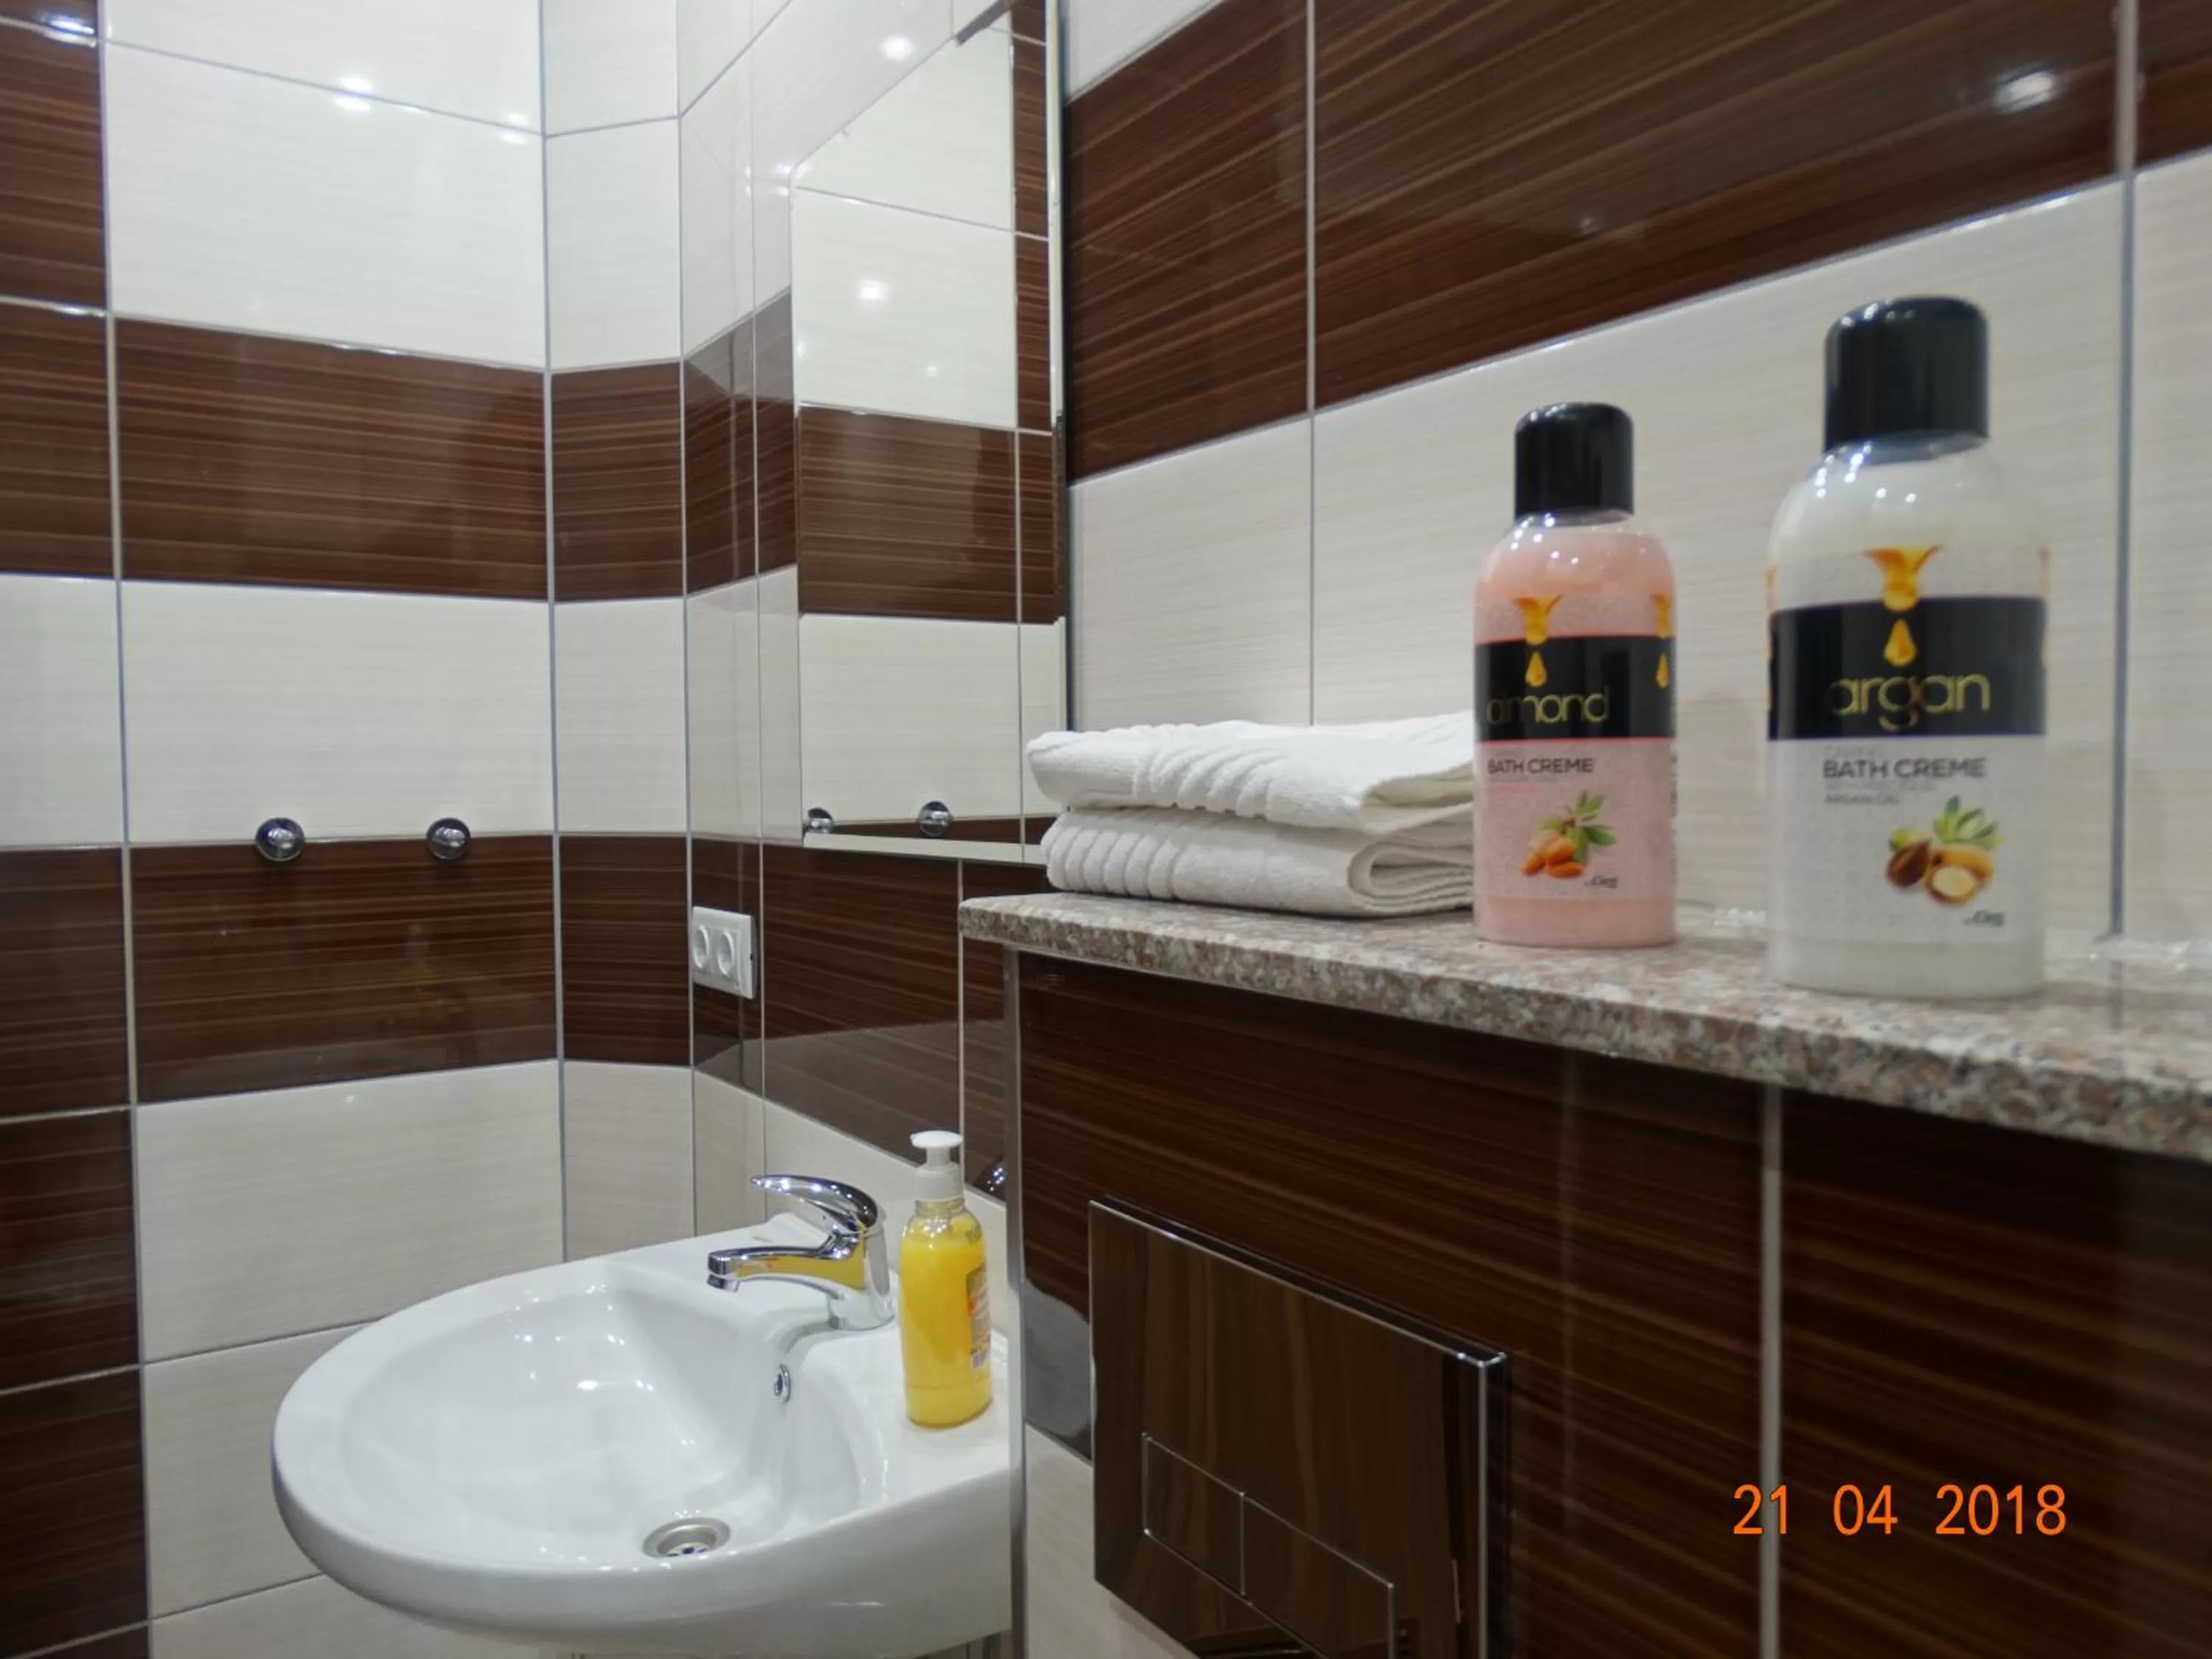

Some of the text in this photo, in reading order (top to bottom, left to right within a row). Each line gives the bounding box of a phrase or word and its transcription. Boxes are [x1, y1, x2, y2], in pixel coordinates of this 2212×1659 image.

[1827, 674, 1990, 731] argan
[1488, 757, 1593, 773] BATH CREME
[1823, 757, 1986, 779] BATH CREME
